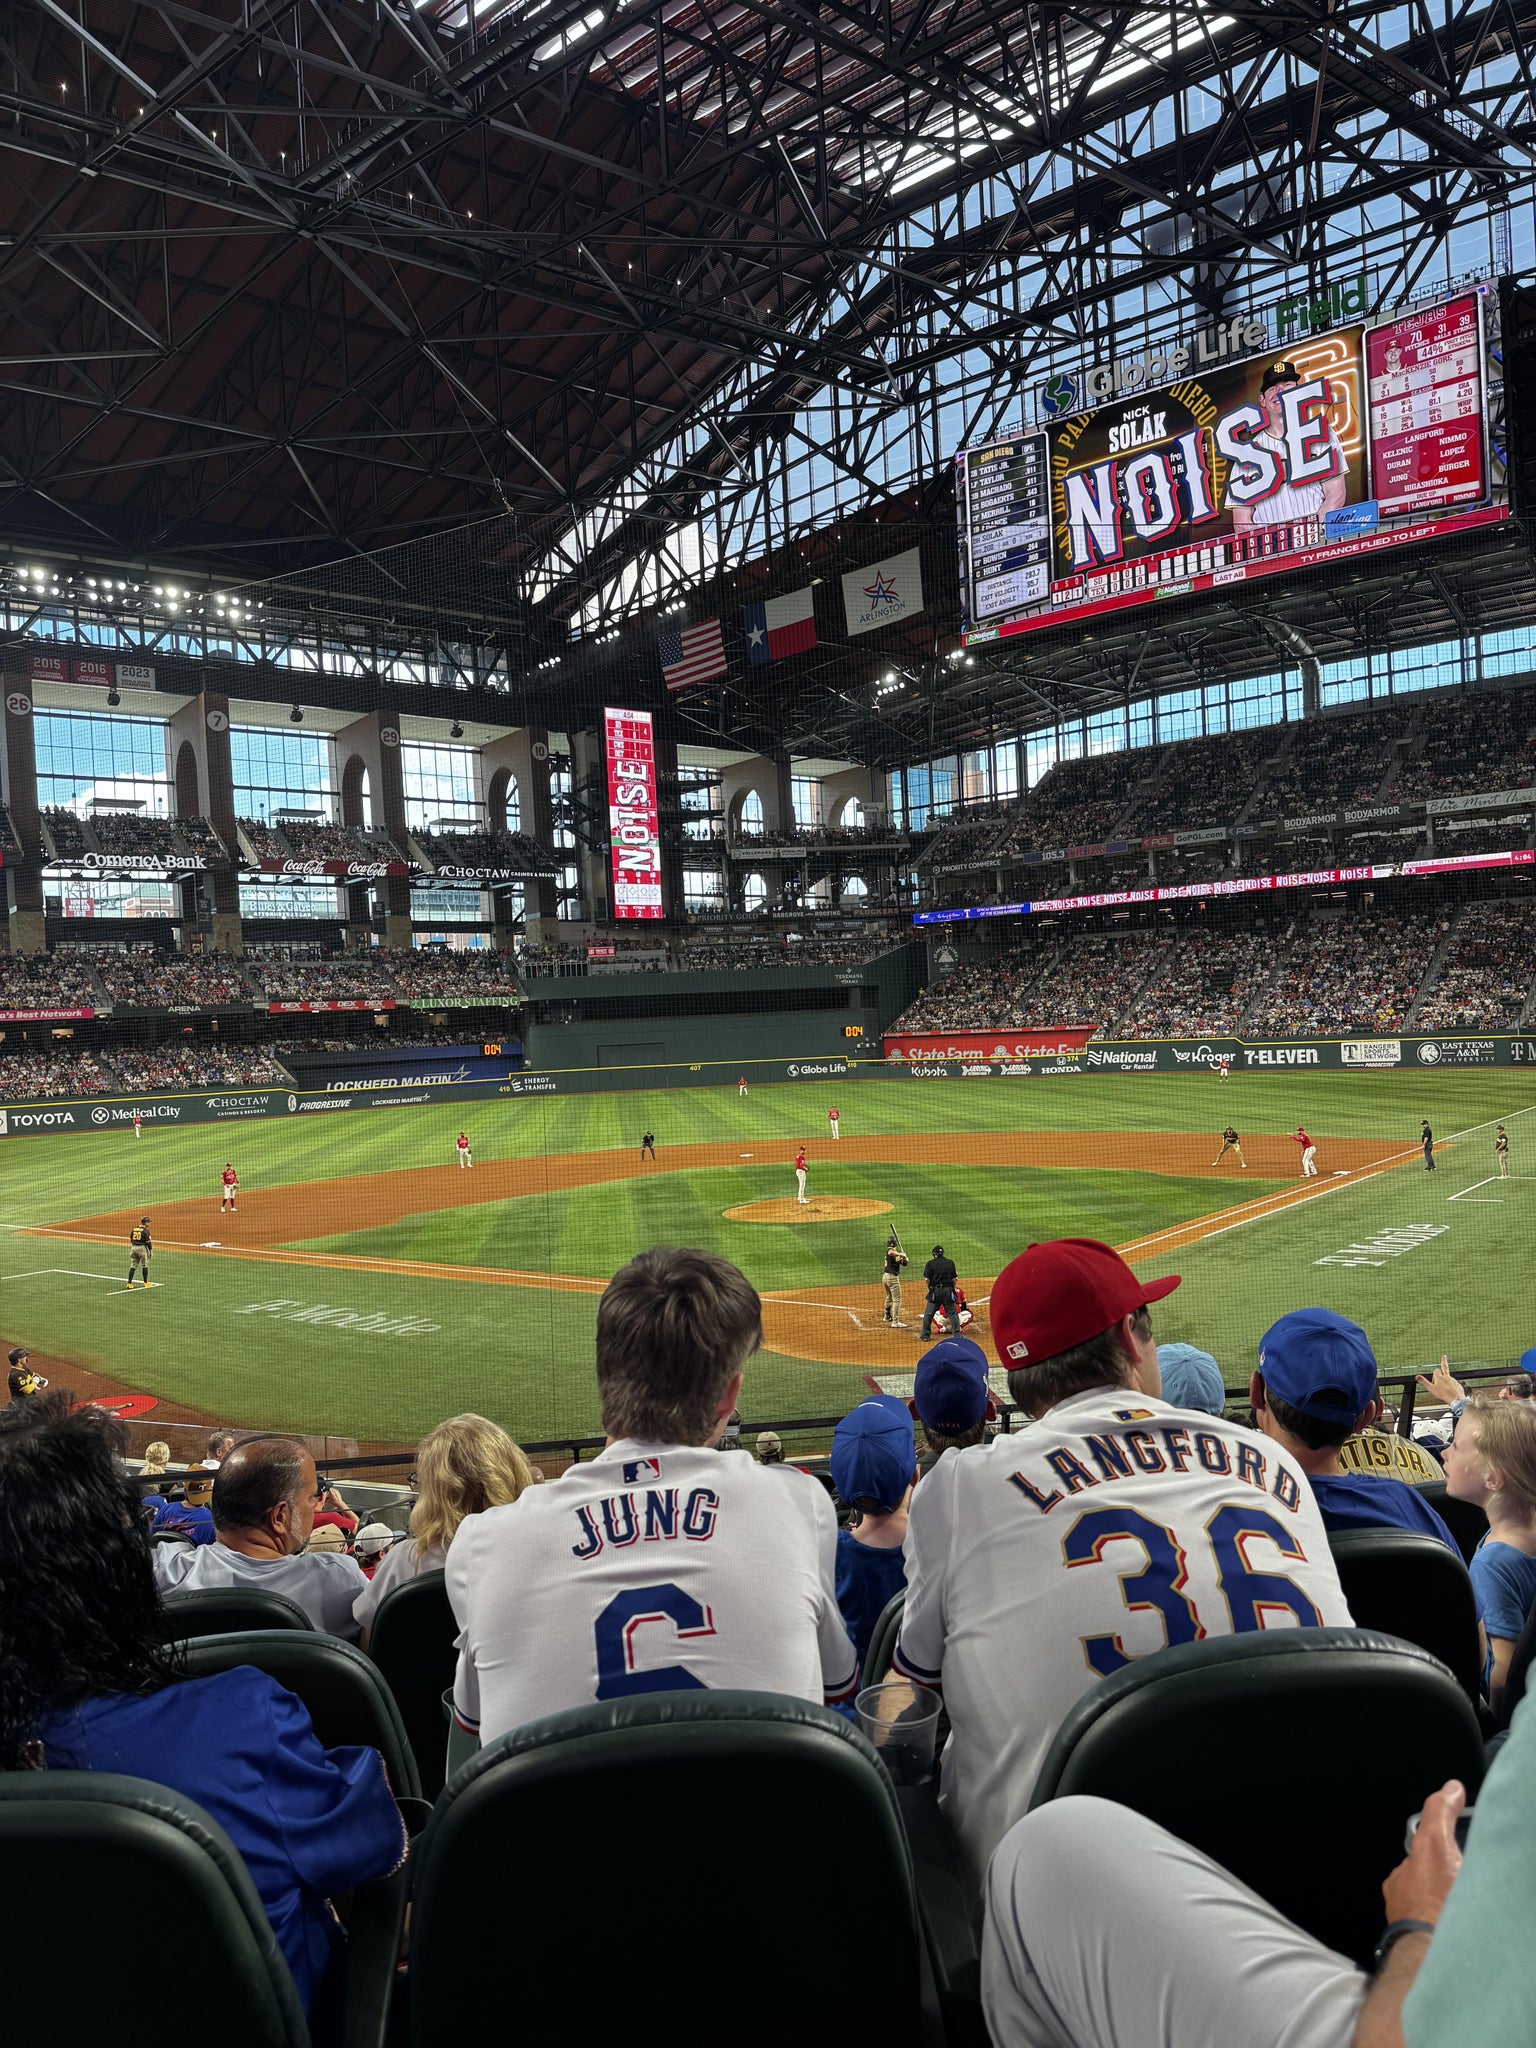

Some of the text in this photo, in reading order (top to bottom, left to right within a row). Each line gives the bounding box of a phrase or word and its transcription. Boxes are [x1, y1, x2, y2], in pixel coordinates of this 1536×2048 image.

[1393, 306, 1447, 334] TEJAS
[1410, 315, 1470, 343] 70 31 39
[1086, 275, 1368, 398] Globe Life Field
[1405, 339, 1430, 352] PITCHES
[1422, 344, 1443, 358] 44%
[1433, 355, 1452, 366] GORE
[1169, 381, 1218, 426] DIEGO
[1123, 405, 1150, 422] NICK
[1109, 412, 1166, 453] SOLAK
[1405, 428, 1444, 443] LANGFORD
[1383, 433, 1467, 459] KELENIC NIMMO
[981, 447, 1014, 463] SAN DIEGO
[1387, 446, 1465, 470] DURAN LOPEZ
[980, 464, 998, 475] TATIS
[1062, 376, 1339, 572] NOISE
[1389, 460, 1470, 483] JUNG BURGER
[980, 474, 1004, 486] TAYLOR
[1404, 477, 1448, 492] HIGASHIOKA
[980, 483, 1012, 498] MACHADO
[980, 493, 1014, 508] BOGAERTS
[1412, 492, 1476, 508] LANGFORD NIMMO
[981, 506, 1010, 519] MERRILL
[982, 530, 1003, 542] SOLAK
[1317, 543, 1360, 560] FRANCE
[1360, 536, 1390, 549] FLIED
[1392, 533, 1408, 541] TO
[1410, 526, 1437, 538] LEFT
[983, 551, 1007, 564] BOWEN
[984, 564, 1002, 576] HUNT
[988, 578, 1013, 590] DISTANCE
[1215, 574, 1232, 582] LAST
[995, 585, 1019, 598] VELOCITY
[1091, 587, 1105, 596] TEX
[859, 601, 906, 624] ARLINGTON
[34, 657, 61, 669] 2015
[80, 662, 106, 674] 2016
[122, 666, 150, 678] 2023
[78, 677, 109, 685] CHAMPIONS
[10, 698, 28, 710] 26
[214, 715, 221, 727] 7
[383, 731, 397, 743] 29
[535, 746, 545, 756] 10
[1429, 801, 1459, 813] Blue
[1463, 795, 1497, 809] Mint
[616, 761, 653, 872] NOISE
[1345, 806, 1400, 820] BODYARMOR
[1284, 814, 1337, 828] BODYARMOR
[1177, 831, 1223, 841] GoPGL.com
[1236, 826, 1258, 835] PGL
[165, 855, 207, 869] Bank
[1042, 851, 1065, 861] 105.3
[283, 859, 326, 875] Coca-Cola
[348, 862, 389, 877] Coca-Cola
[446, 866, 510, 878] CHOCTAW
[942, 860, 1001, 872] PRIORITY COMMERCE
[1052, 899, 1075, 909] NOISE
[1077, 896, 1100, 907] NOISE
[1104, 894, 1127, 904] NOISE
[1130, 890, 1154, 901] NOISE
[1158, 889, 1184, 899] NOISE
[1186, 886, 1212, 896] NOISE
[1214, 883, 1243, 894] NOISE
[1244, 879, 1272, 890] NOISE
[1276, 875, 1303, 886] NOISE
[1308, 872, 1335, 883] NOISE
[1340, 868, 1368, 880] NOISE
[637, 910, 642, 918] 2
[422, 997, 518, 1008] LUXOR STAFFING
[16, 1009, 83, 1019] Best Network
[909, 1047, 983, 1059] State Farm
[1014, 1044, 1055, 1056] State
[1192, 1046, 1236, 1070] Kroger
[801, 1064, 846, 1074] Globe Life
[911, 1066, 948, 1076] Kubota
[1042, 1065, 1082, 1074] HONDA
[327, 1075, 451, 1091] LOCKHEED MARTIN
[212, 1096, 269, 1108] CHOCTAW
[299, 1099, 352, 1110] PROGRESSIVE
[12, 1113, 75, 1126] TOYOTA
[111, 1106, 181, 1120] Medical City
[1396, 1446, 1434, 1478] JR.
[1006, 1428, 1300, 1514] LANGFORD
[572, 1487, 720, 1560] JUNG
[1060, 1503, 1324, 1678] 36
[594, 1582, 717, 1700] 6
